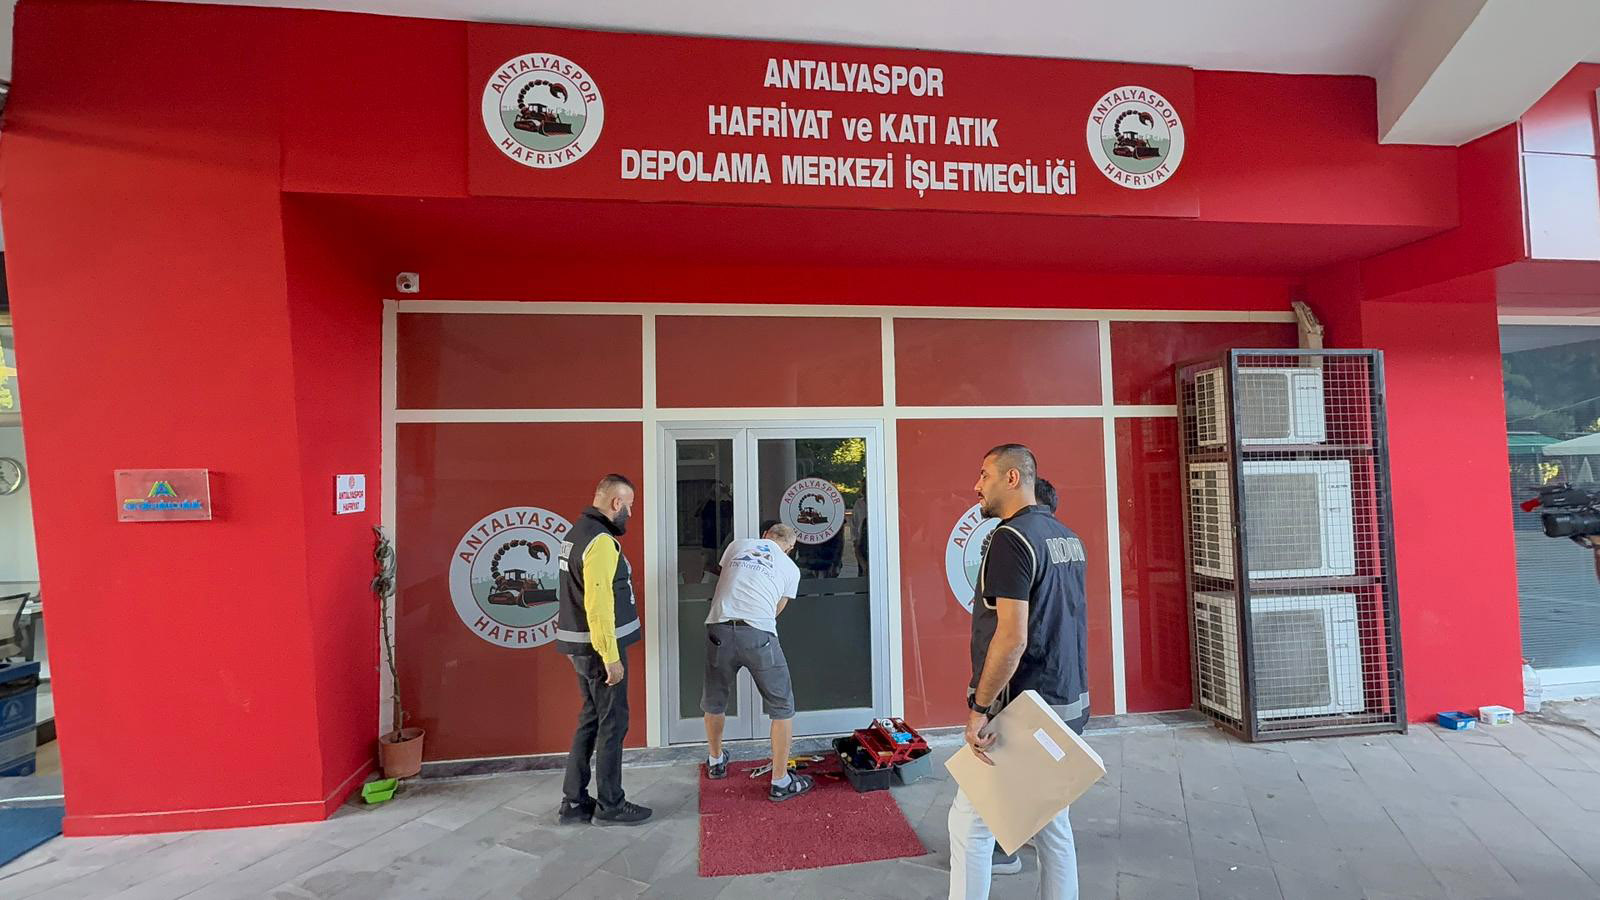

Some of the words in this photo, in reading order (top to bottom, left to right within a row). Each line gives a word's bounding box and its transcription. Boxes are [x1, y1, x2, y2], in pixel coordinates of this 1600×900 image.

[491, 57, 597, 103] ANTALYASPOR
[764, 58, 944, 97] ANTALYASPOR
[708, 102, 832, 140] HAFRİYAT
[842, 118, 873, 142] ve
[880, 113, 936, 144] KATI
[945, 116, 999, 147] ATIK
[1093, 89, 1177, 129] ANTALYASPOR
[621, 149, 772, 184] DEPOLAMA
[782, 153, 894, 188] MERKEZİ
[905, 154, 1076, 198] İŞLETMECİLİĞİ
[784, 480, 841, 504] ANTALYASPOR
[459, 511, 567, 564] ANTALYASP
